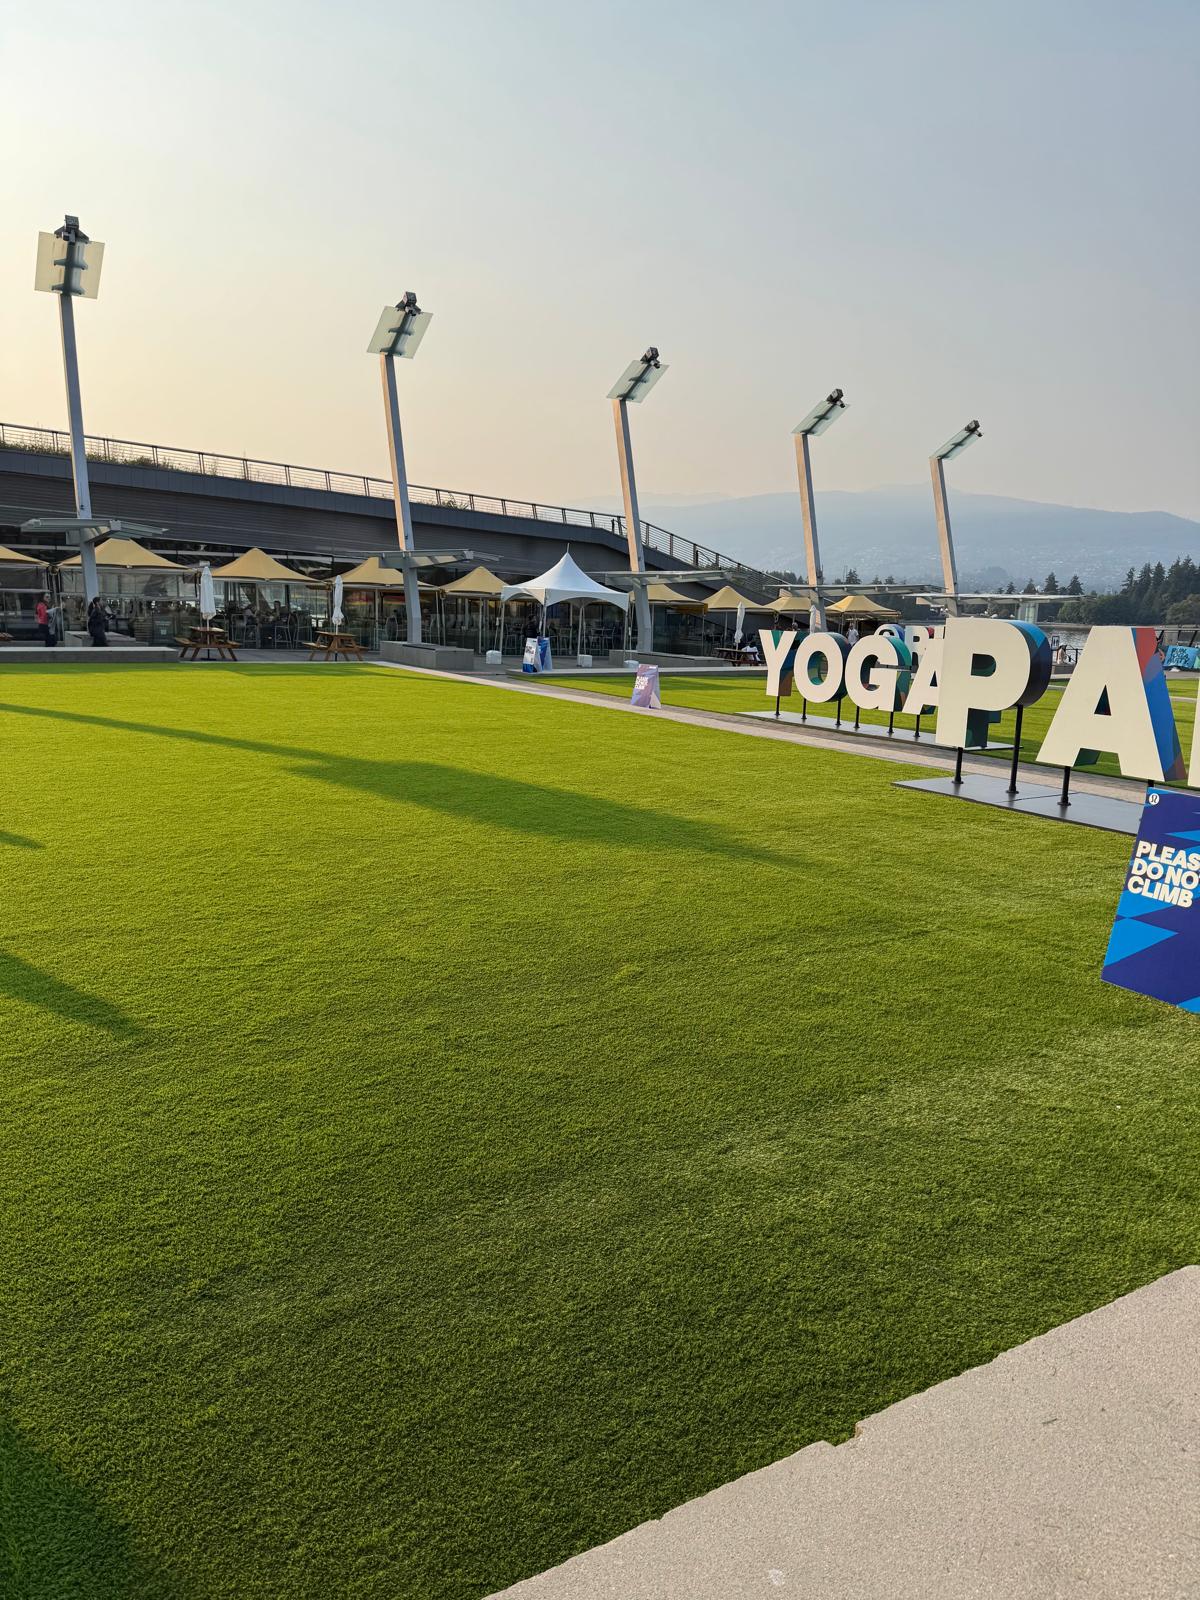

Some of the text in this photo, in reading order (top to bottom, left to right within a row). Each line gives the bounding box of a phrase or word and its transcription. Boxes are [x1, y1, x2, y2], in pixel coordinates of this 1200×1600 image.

[758, 629, 944, 715] YOGA
[935, 617, 1200, 787] PA
[1127, 875, 1194, 908] CLIMB
[1131, 857, 1200, 890] DO NO
